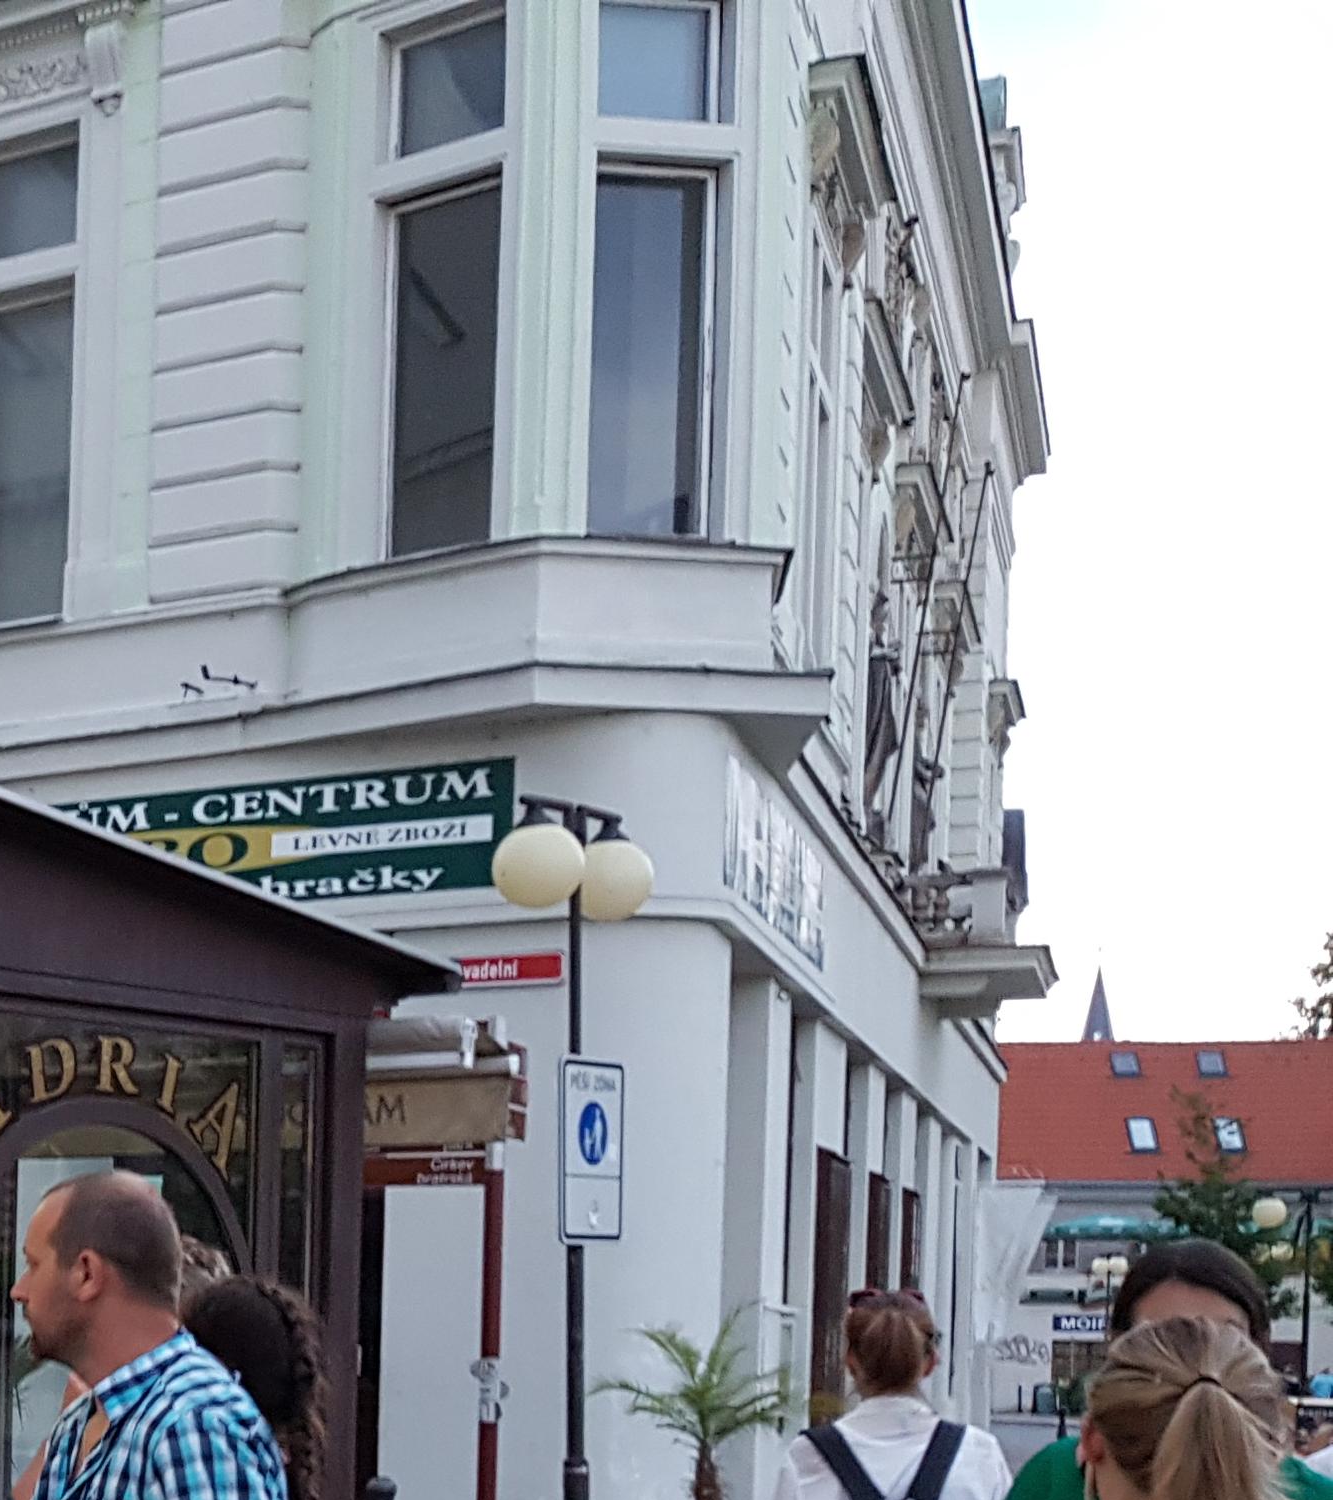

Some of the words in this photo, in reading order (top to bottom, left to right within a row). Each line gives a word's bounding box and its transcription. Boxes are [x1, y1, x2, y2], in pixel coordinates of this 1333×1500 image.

[192, 767, 493, 825] CENTRUM
[259, 864, 444, 897] hračky
[461, 958, 518, 981] vadelní
